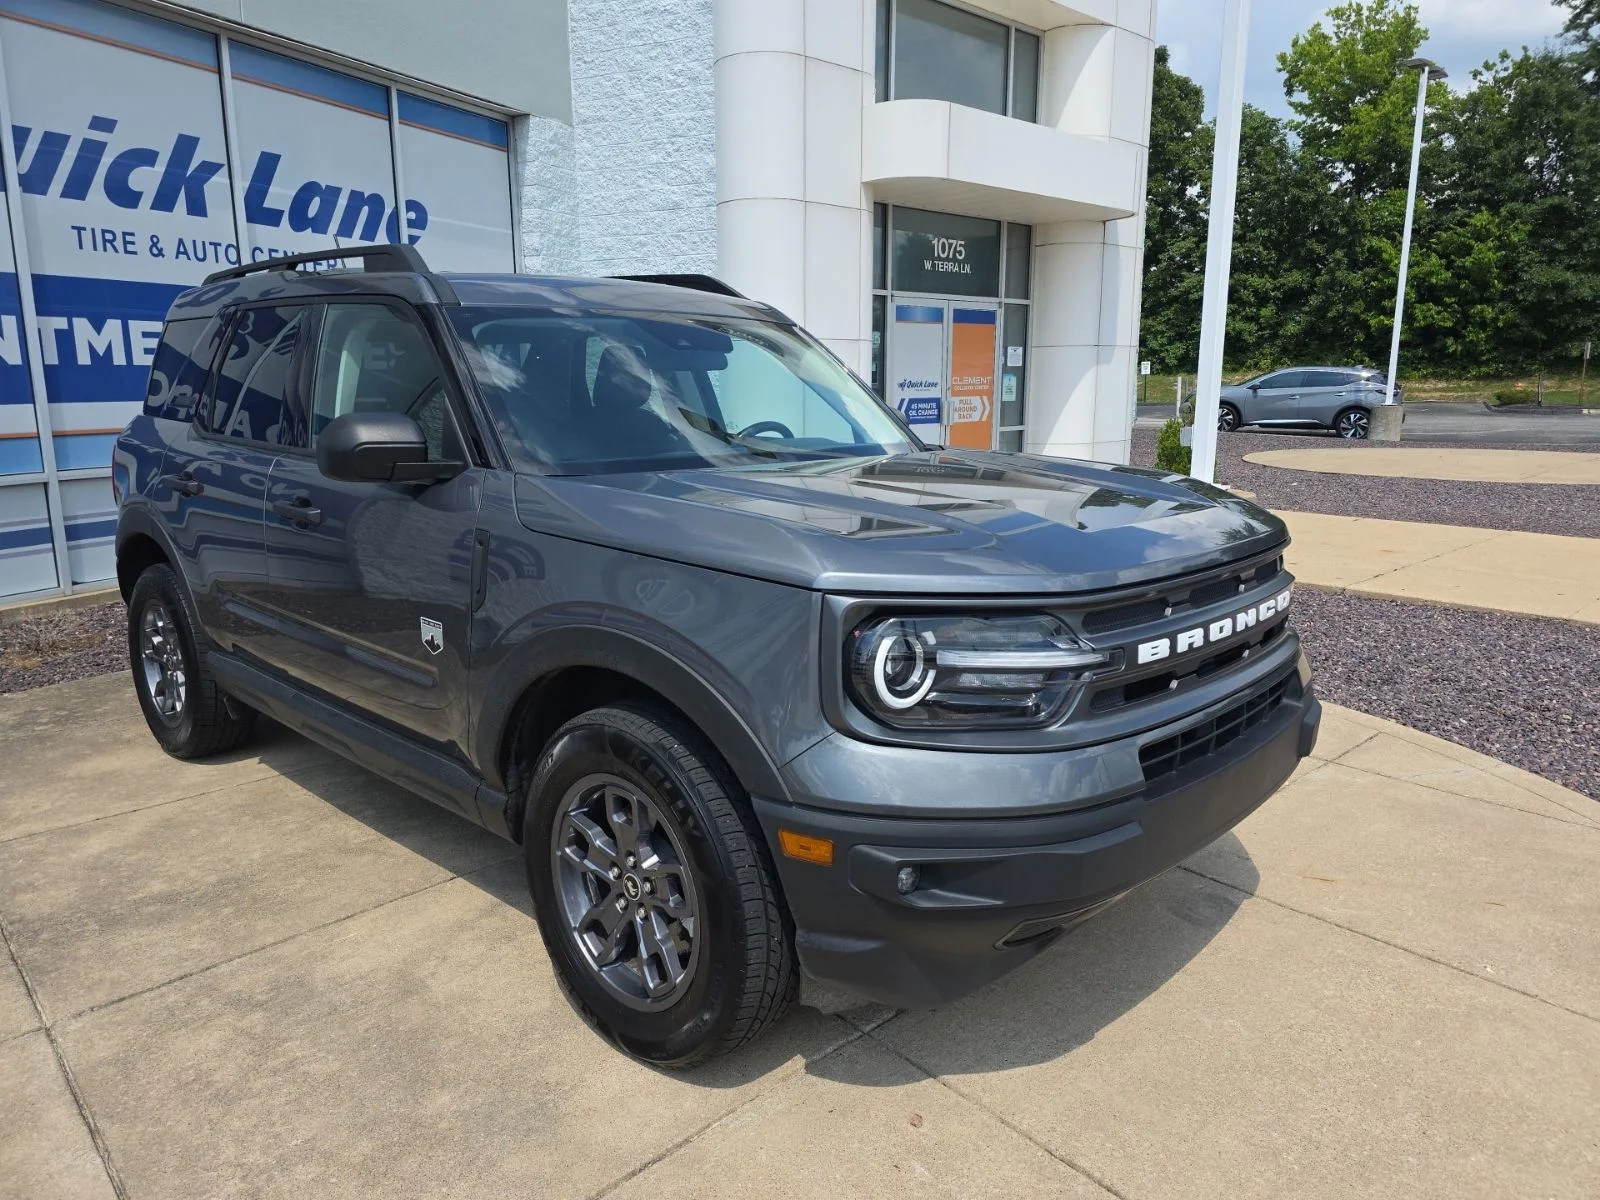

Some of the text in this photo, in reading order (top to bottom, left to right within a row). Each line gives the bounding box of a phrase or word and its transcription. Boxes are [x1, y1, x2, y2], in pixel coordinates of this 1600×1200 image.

[0, 115, 428, 246] uick Lane
[71, 225, 138, 255] TIRE
[148, 234, 165, 258] &
[174, 237, 240, 266] AUTO
[932, 237, 966, 260] 1075
[934, 260, 959, 273] TERRA
[907, 380, 938, 388] Quick Lane
[953, 376, 992, 384] CLEMENT
[958, 398, 973, 406] PULL
[917, 408, 939, 416] CHANGE
[957, 412, 973, 420] BACK
[1137, 590, 1291, 665] BRONCO
